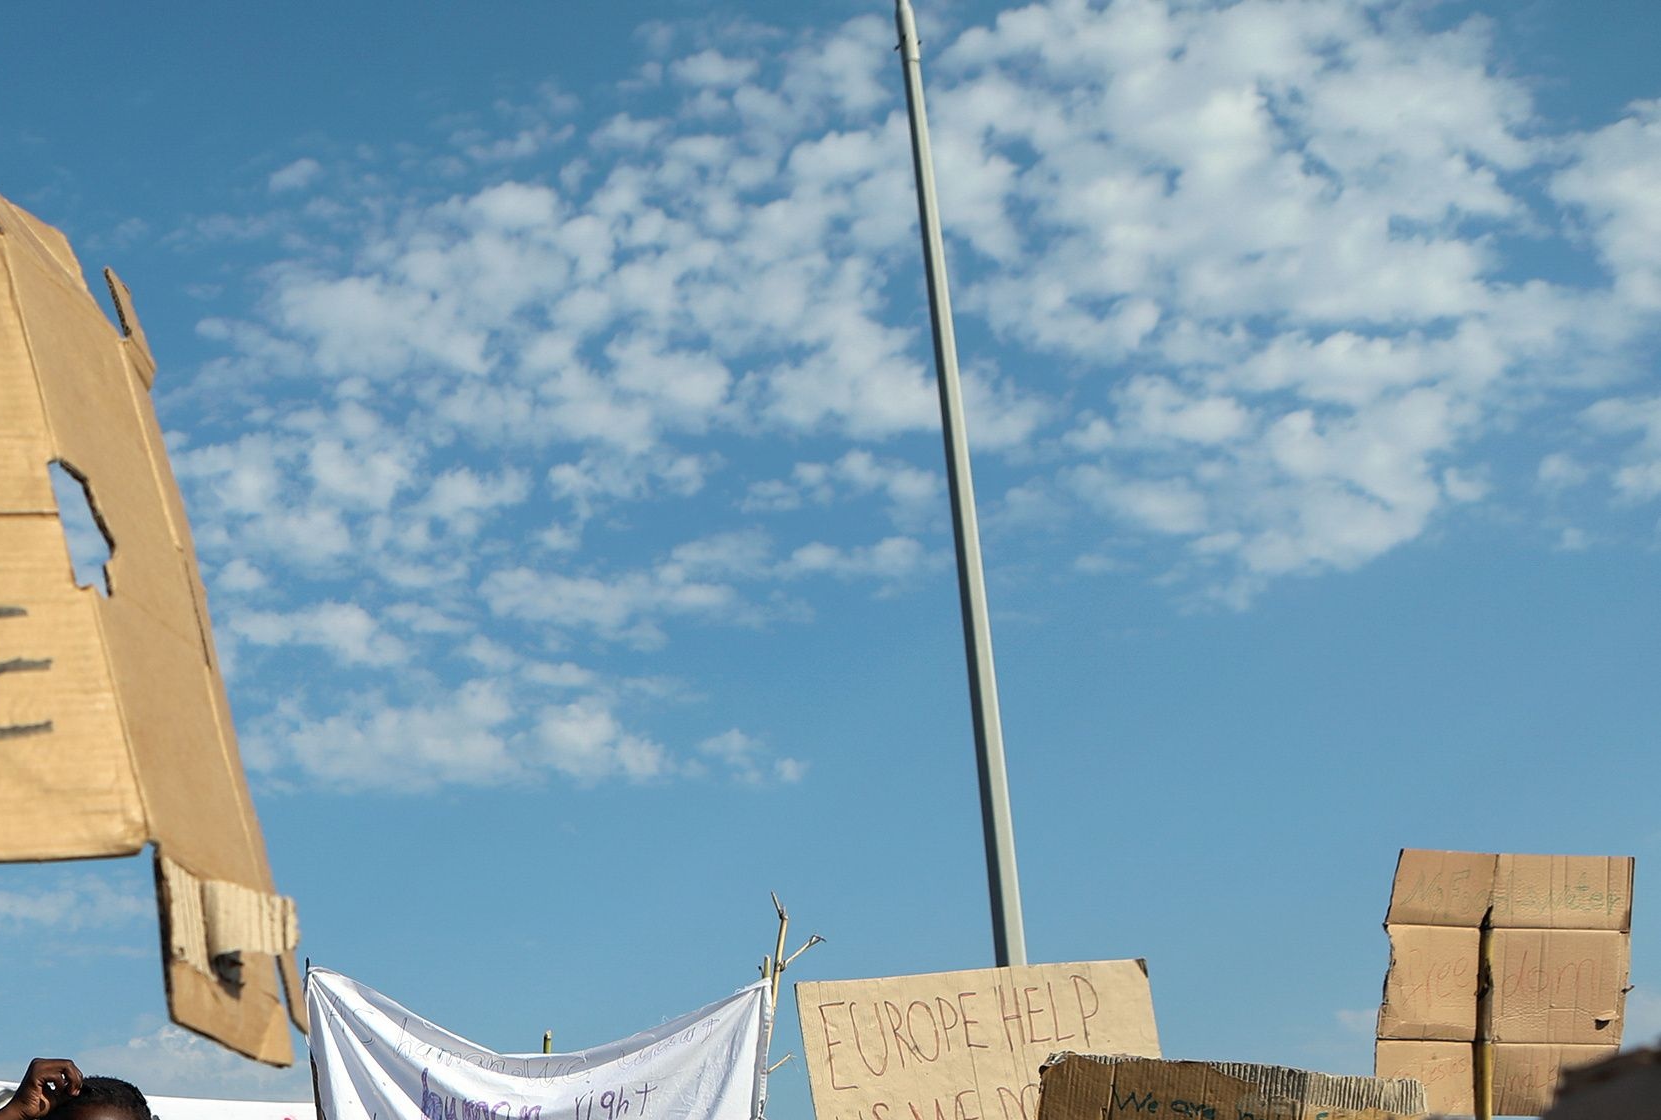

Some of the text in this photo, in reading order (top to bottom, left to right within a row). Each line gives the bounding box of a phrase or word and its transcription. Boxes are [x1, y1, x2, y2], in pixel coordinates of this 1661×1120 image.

[818, 974, 1100, 1091] EUROPE HELP
[1113, 1085, 1157, 1114] We
